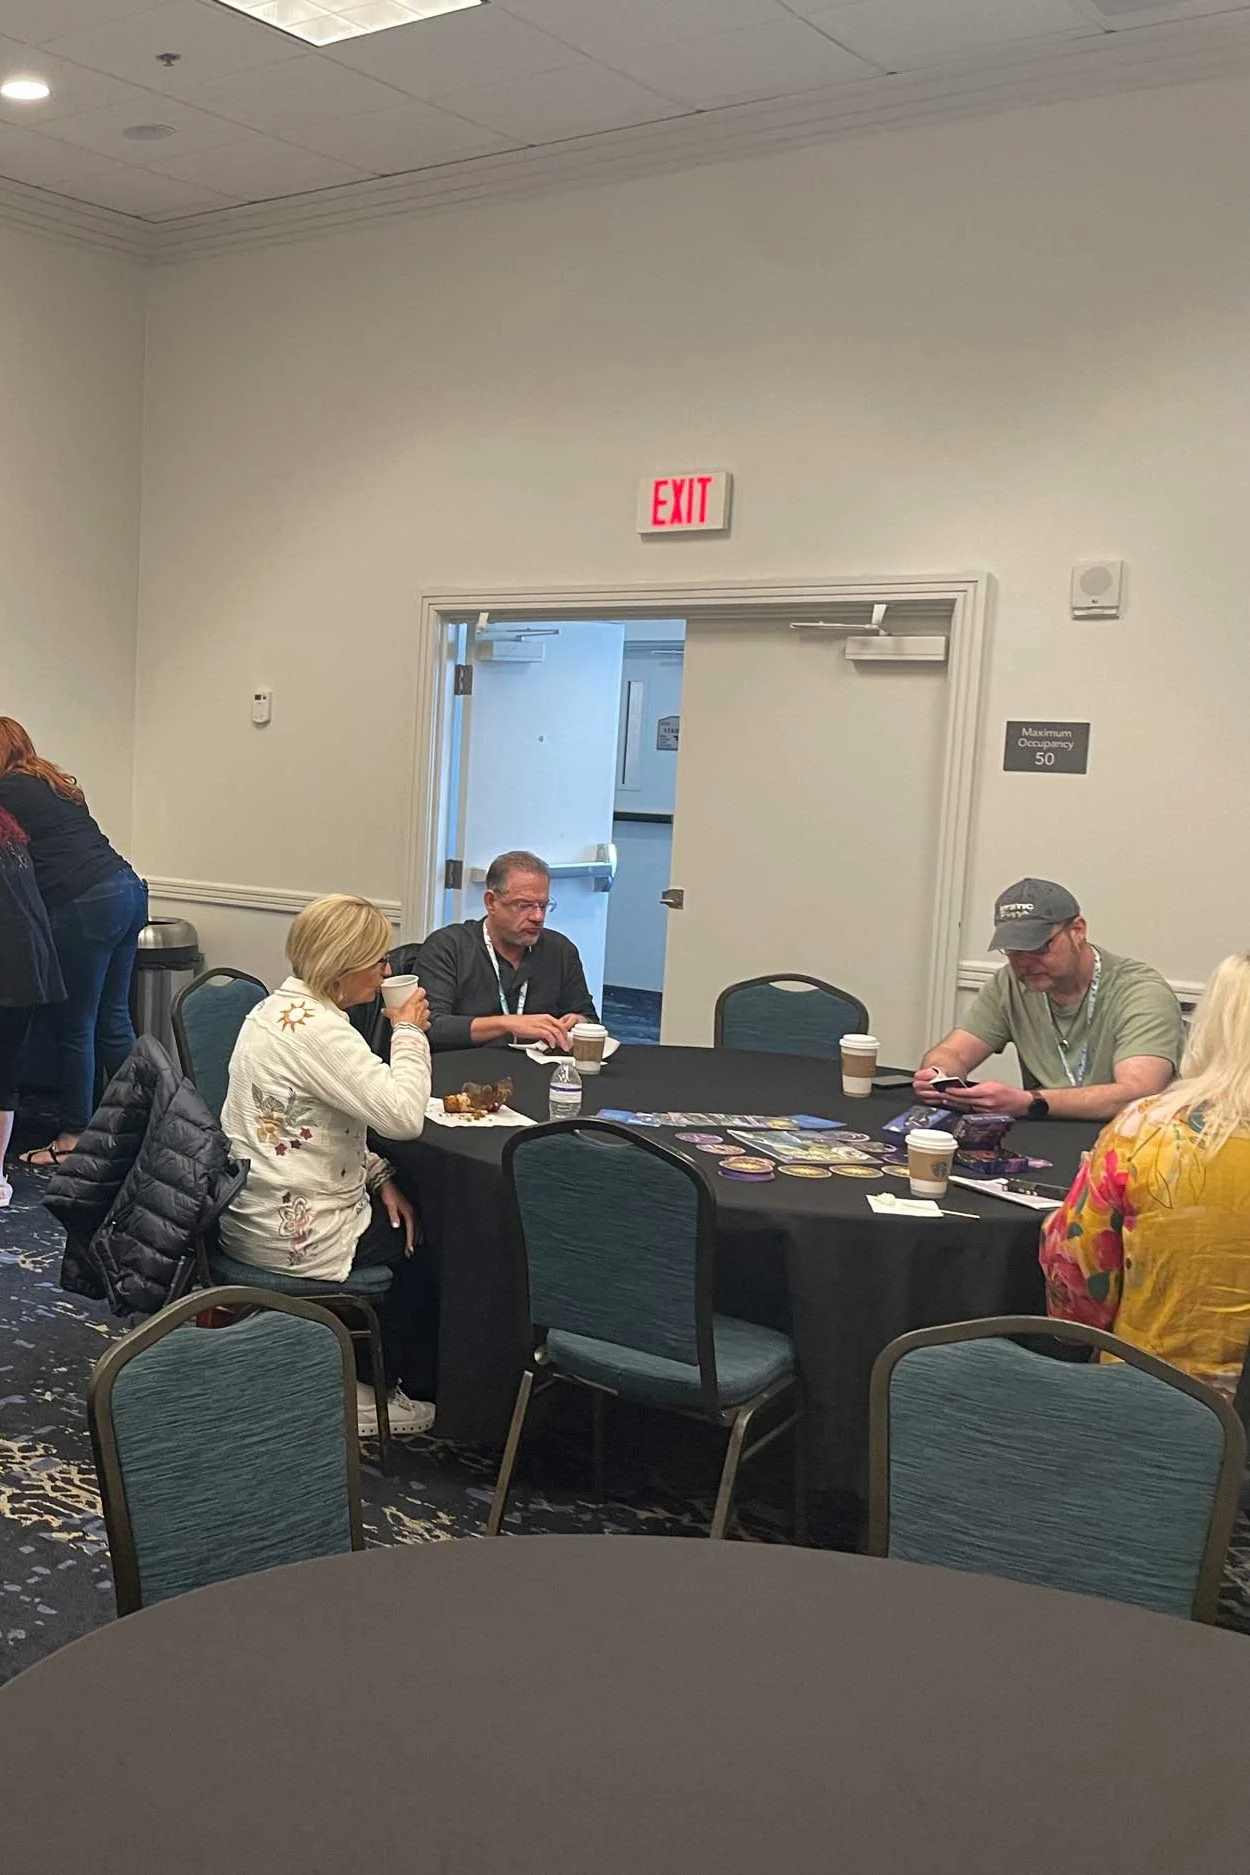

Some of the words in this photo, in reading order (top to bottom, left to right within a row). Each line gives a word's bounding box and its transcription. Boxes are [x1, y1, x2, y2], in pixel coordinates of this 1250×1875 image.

[651, 475, 713, 526] EXIT
[1022, 728, 1072, 737] Maximum
[1017, 738, 1075, 750] Occupancy
[1034, 752, 1055, 765] 50
